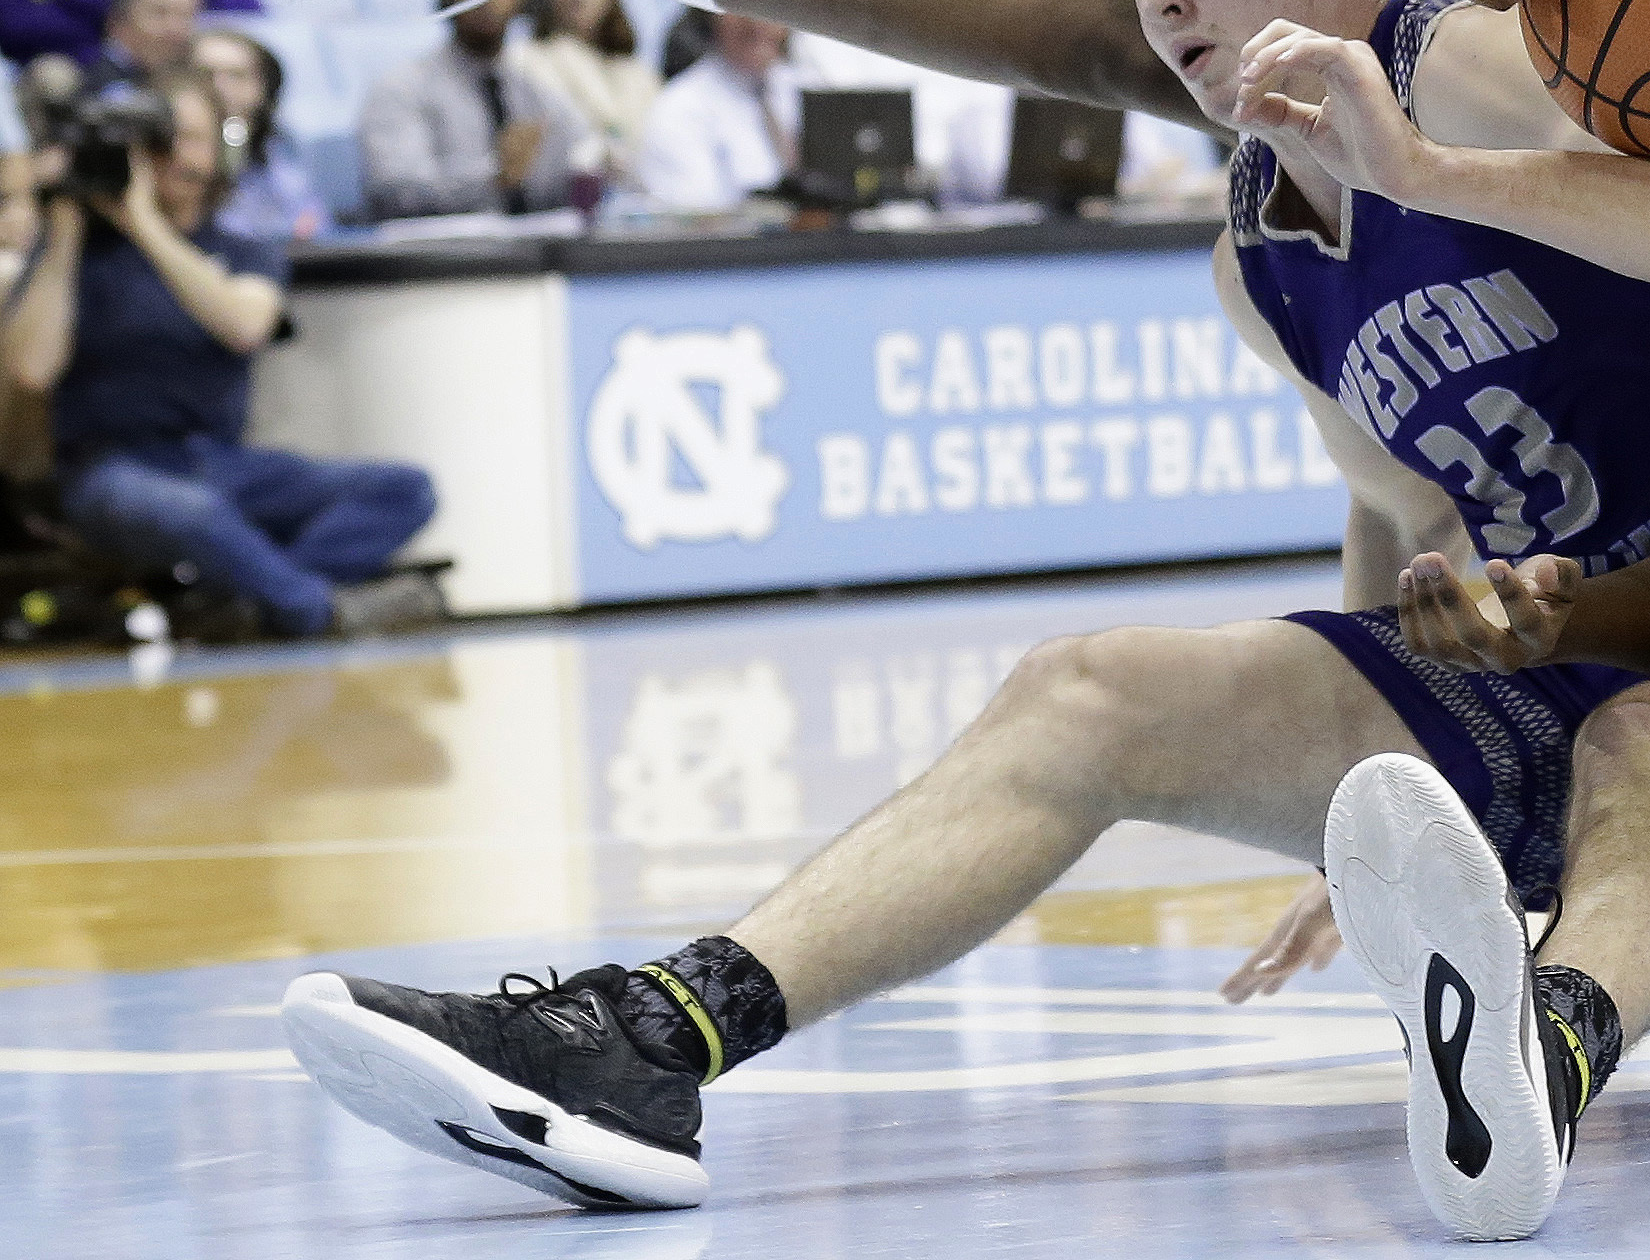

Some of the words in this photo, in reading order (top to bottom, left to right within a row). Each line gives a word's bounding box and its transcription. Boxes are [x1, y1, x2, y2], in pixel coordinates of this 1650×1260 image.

[874, 312, 1280, 417] CAROLINA
[1338, 267, 1560, 455] WESTERN
[818, 404, 1342, 522] BASKETBALL
[1414, 385, 1600, 556] 33
